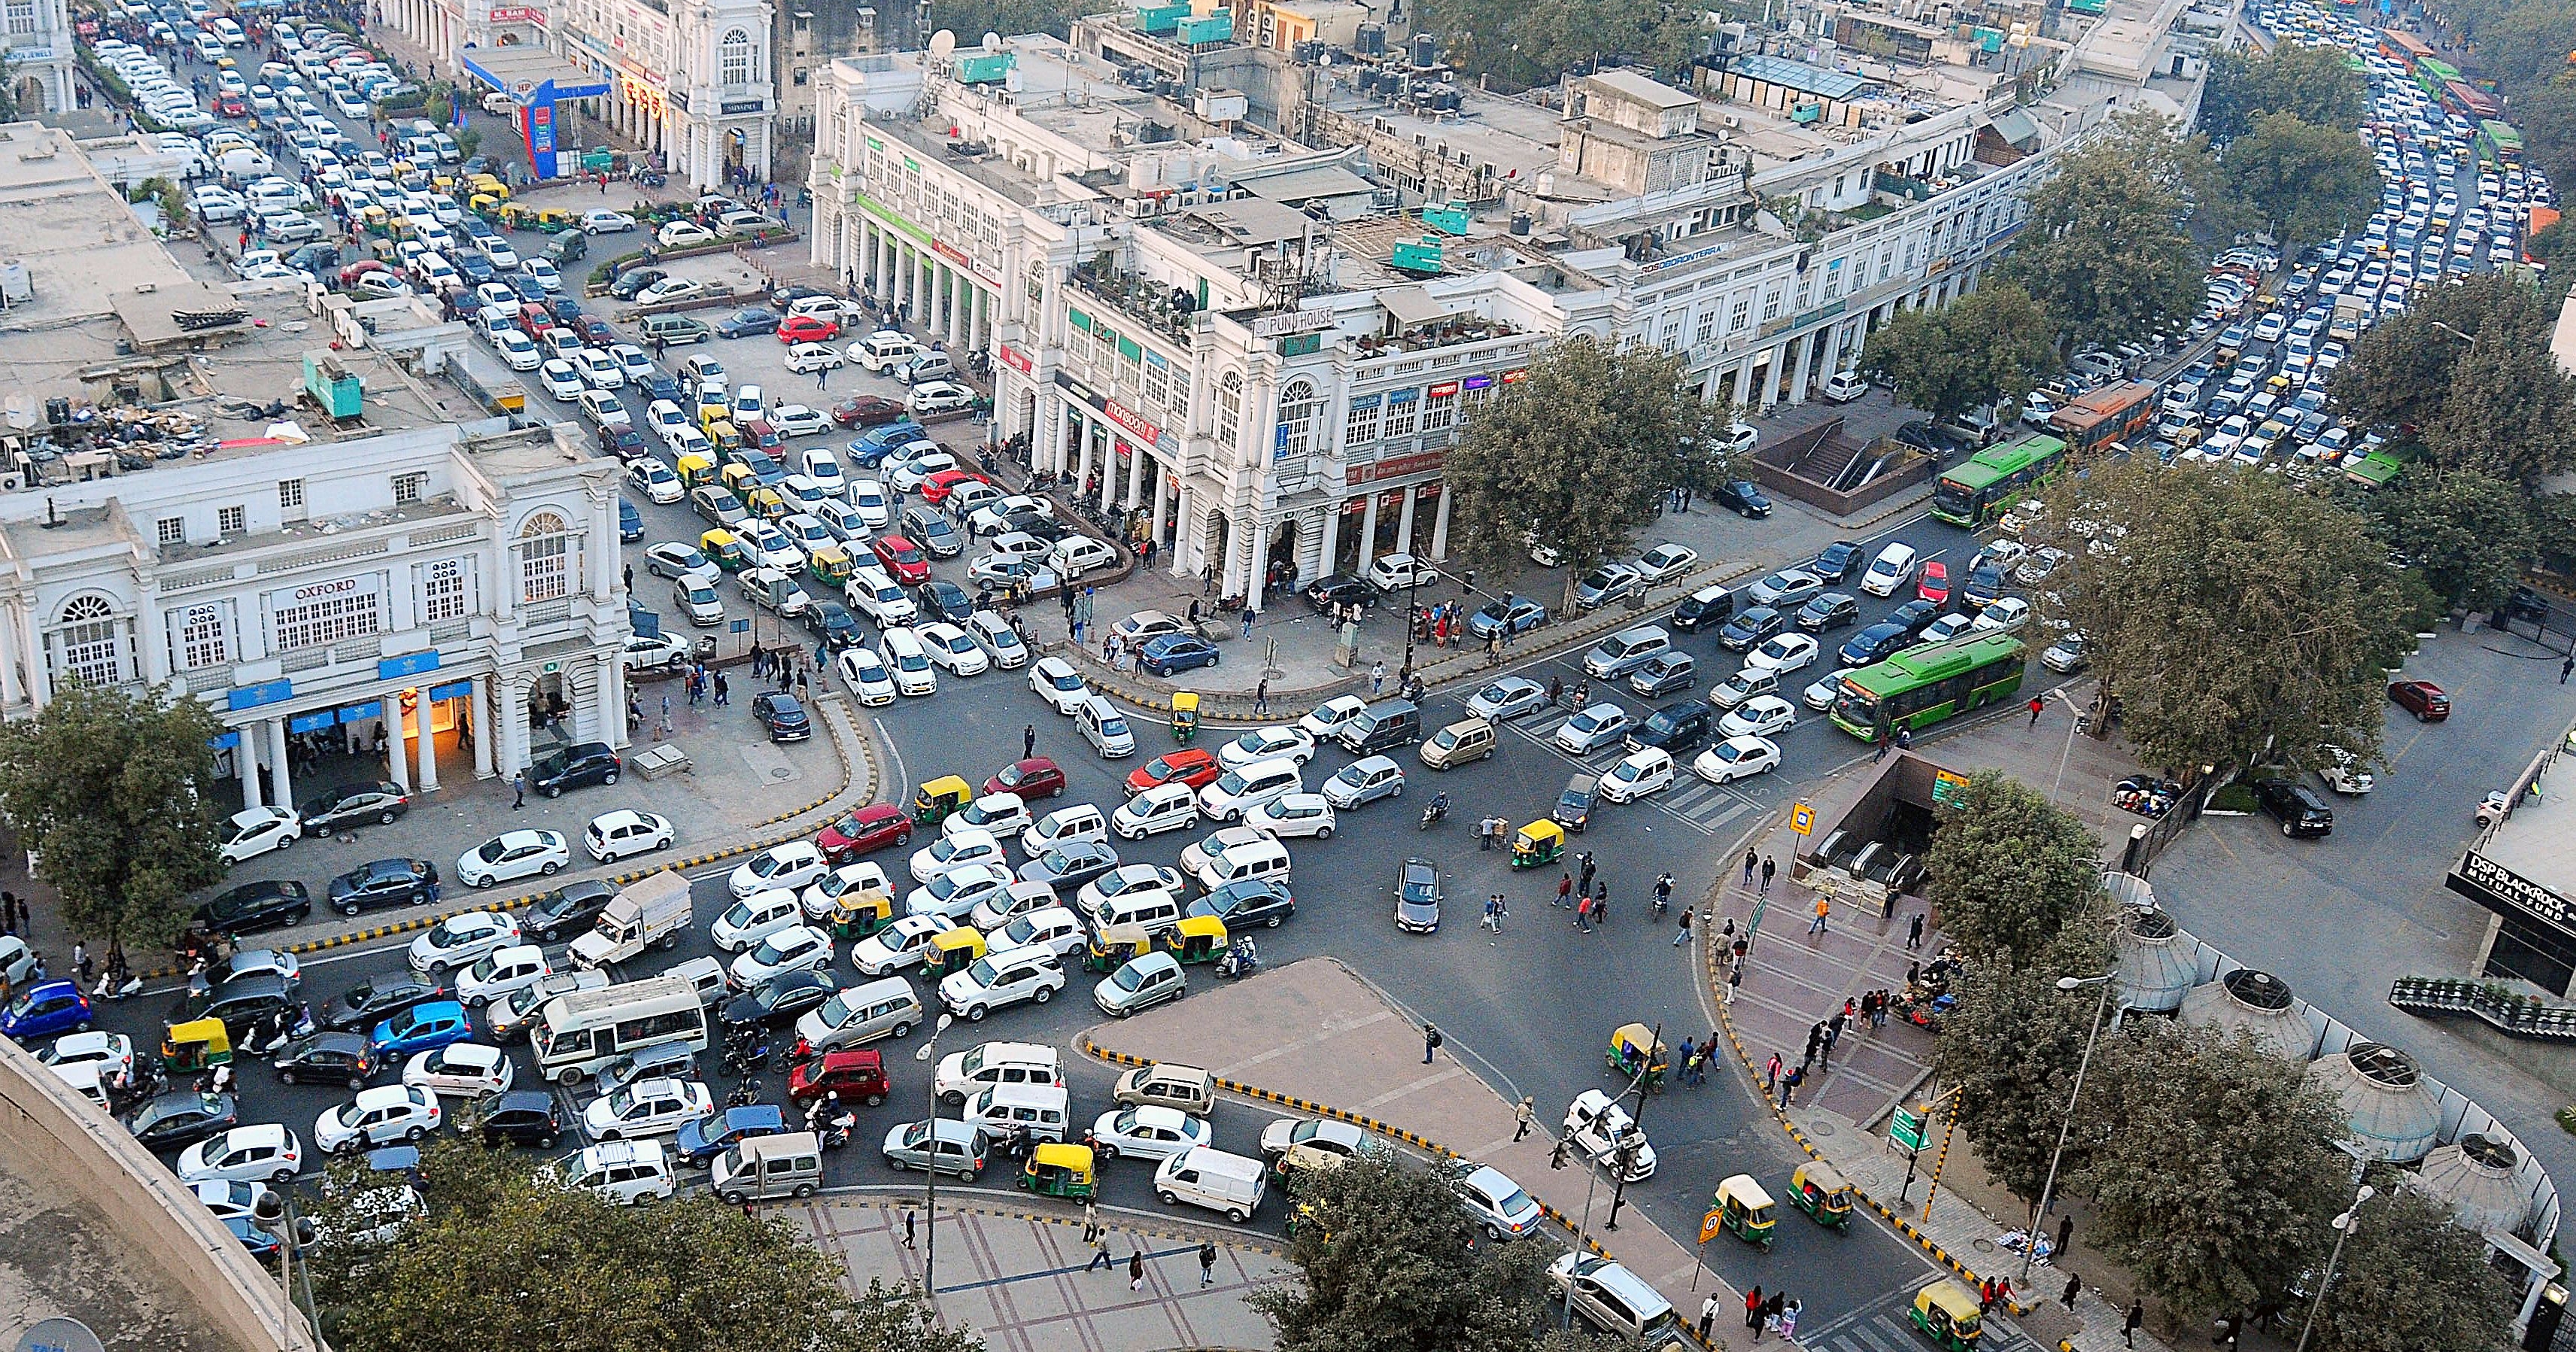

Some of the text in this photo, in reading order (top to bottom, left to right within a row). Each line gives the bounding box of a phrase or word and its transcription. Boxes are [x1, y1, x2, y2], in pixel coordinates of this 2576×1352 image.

[518, 84, 530, 93] HP
[981, 264, 997, 280] airtel
[1270, 309, 1332, 333] PUNJ HOUSE
[1107, 401, 1145, 433] monsoon
[295, 579, 356, 600] OXFORD
[2470, 855, 2497, 875] DSP
[2467, 867, 2563, 922] MUTUAL FUND
